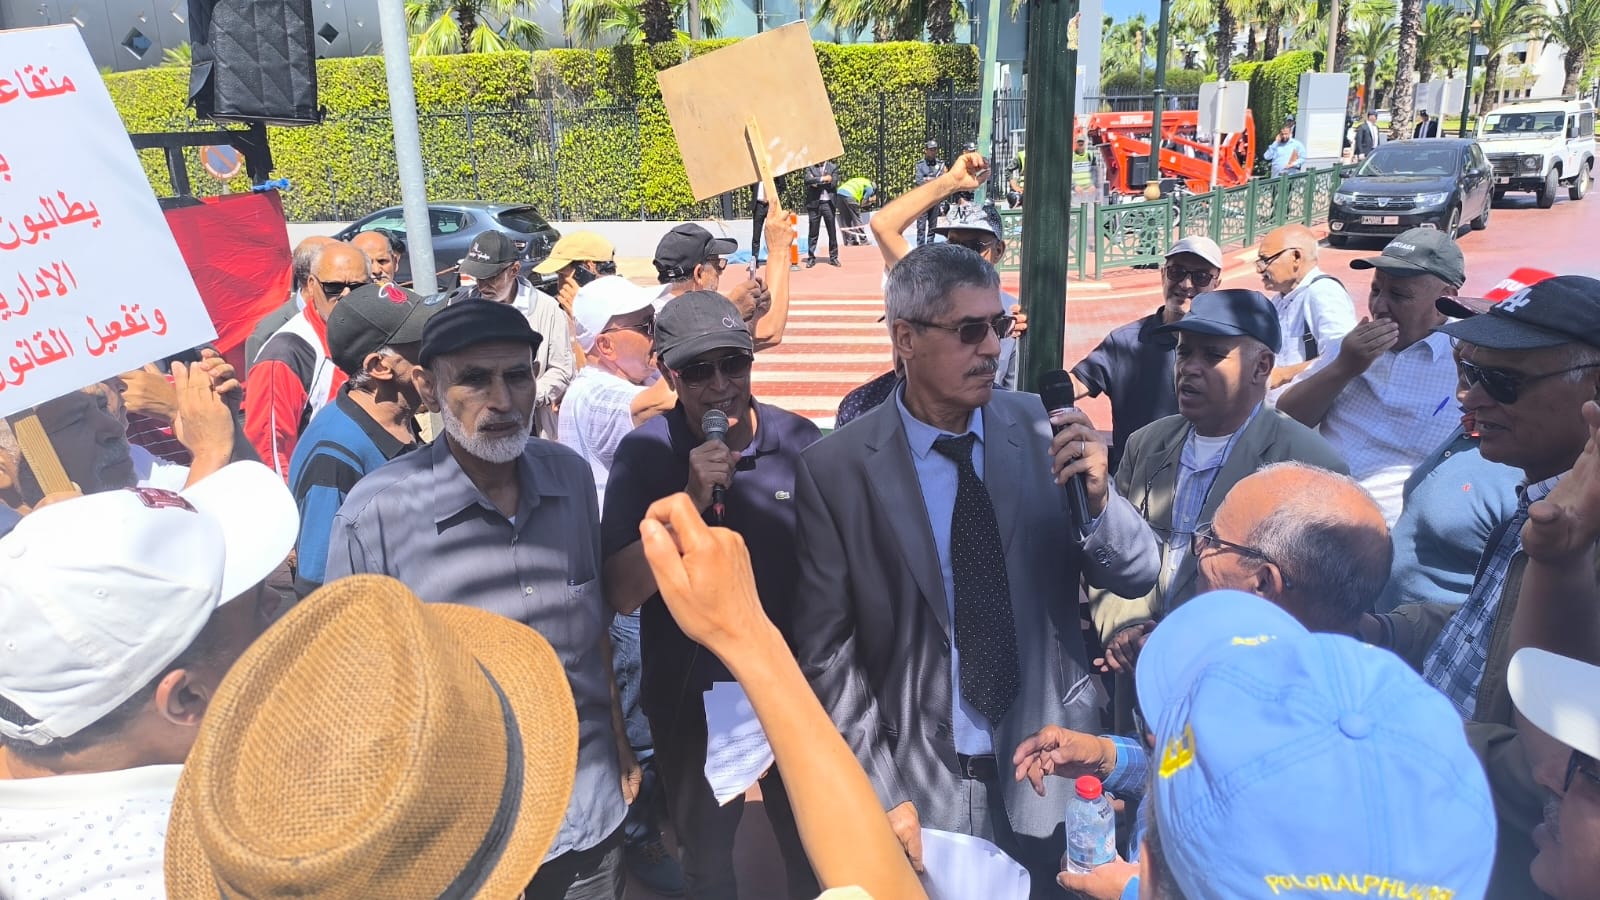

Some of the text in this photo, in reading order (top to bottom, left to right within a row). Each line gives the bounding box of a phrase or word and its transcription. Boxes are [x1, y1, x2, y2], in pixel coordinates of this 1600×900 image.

[0, 64, 76, 104] متقاع
[0, 260, 77, 321] الاداري
[85, 303, 168, 357] وتفعيل
